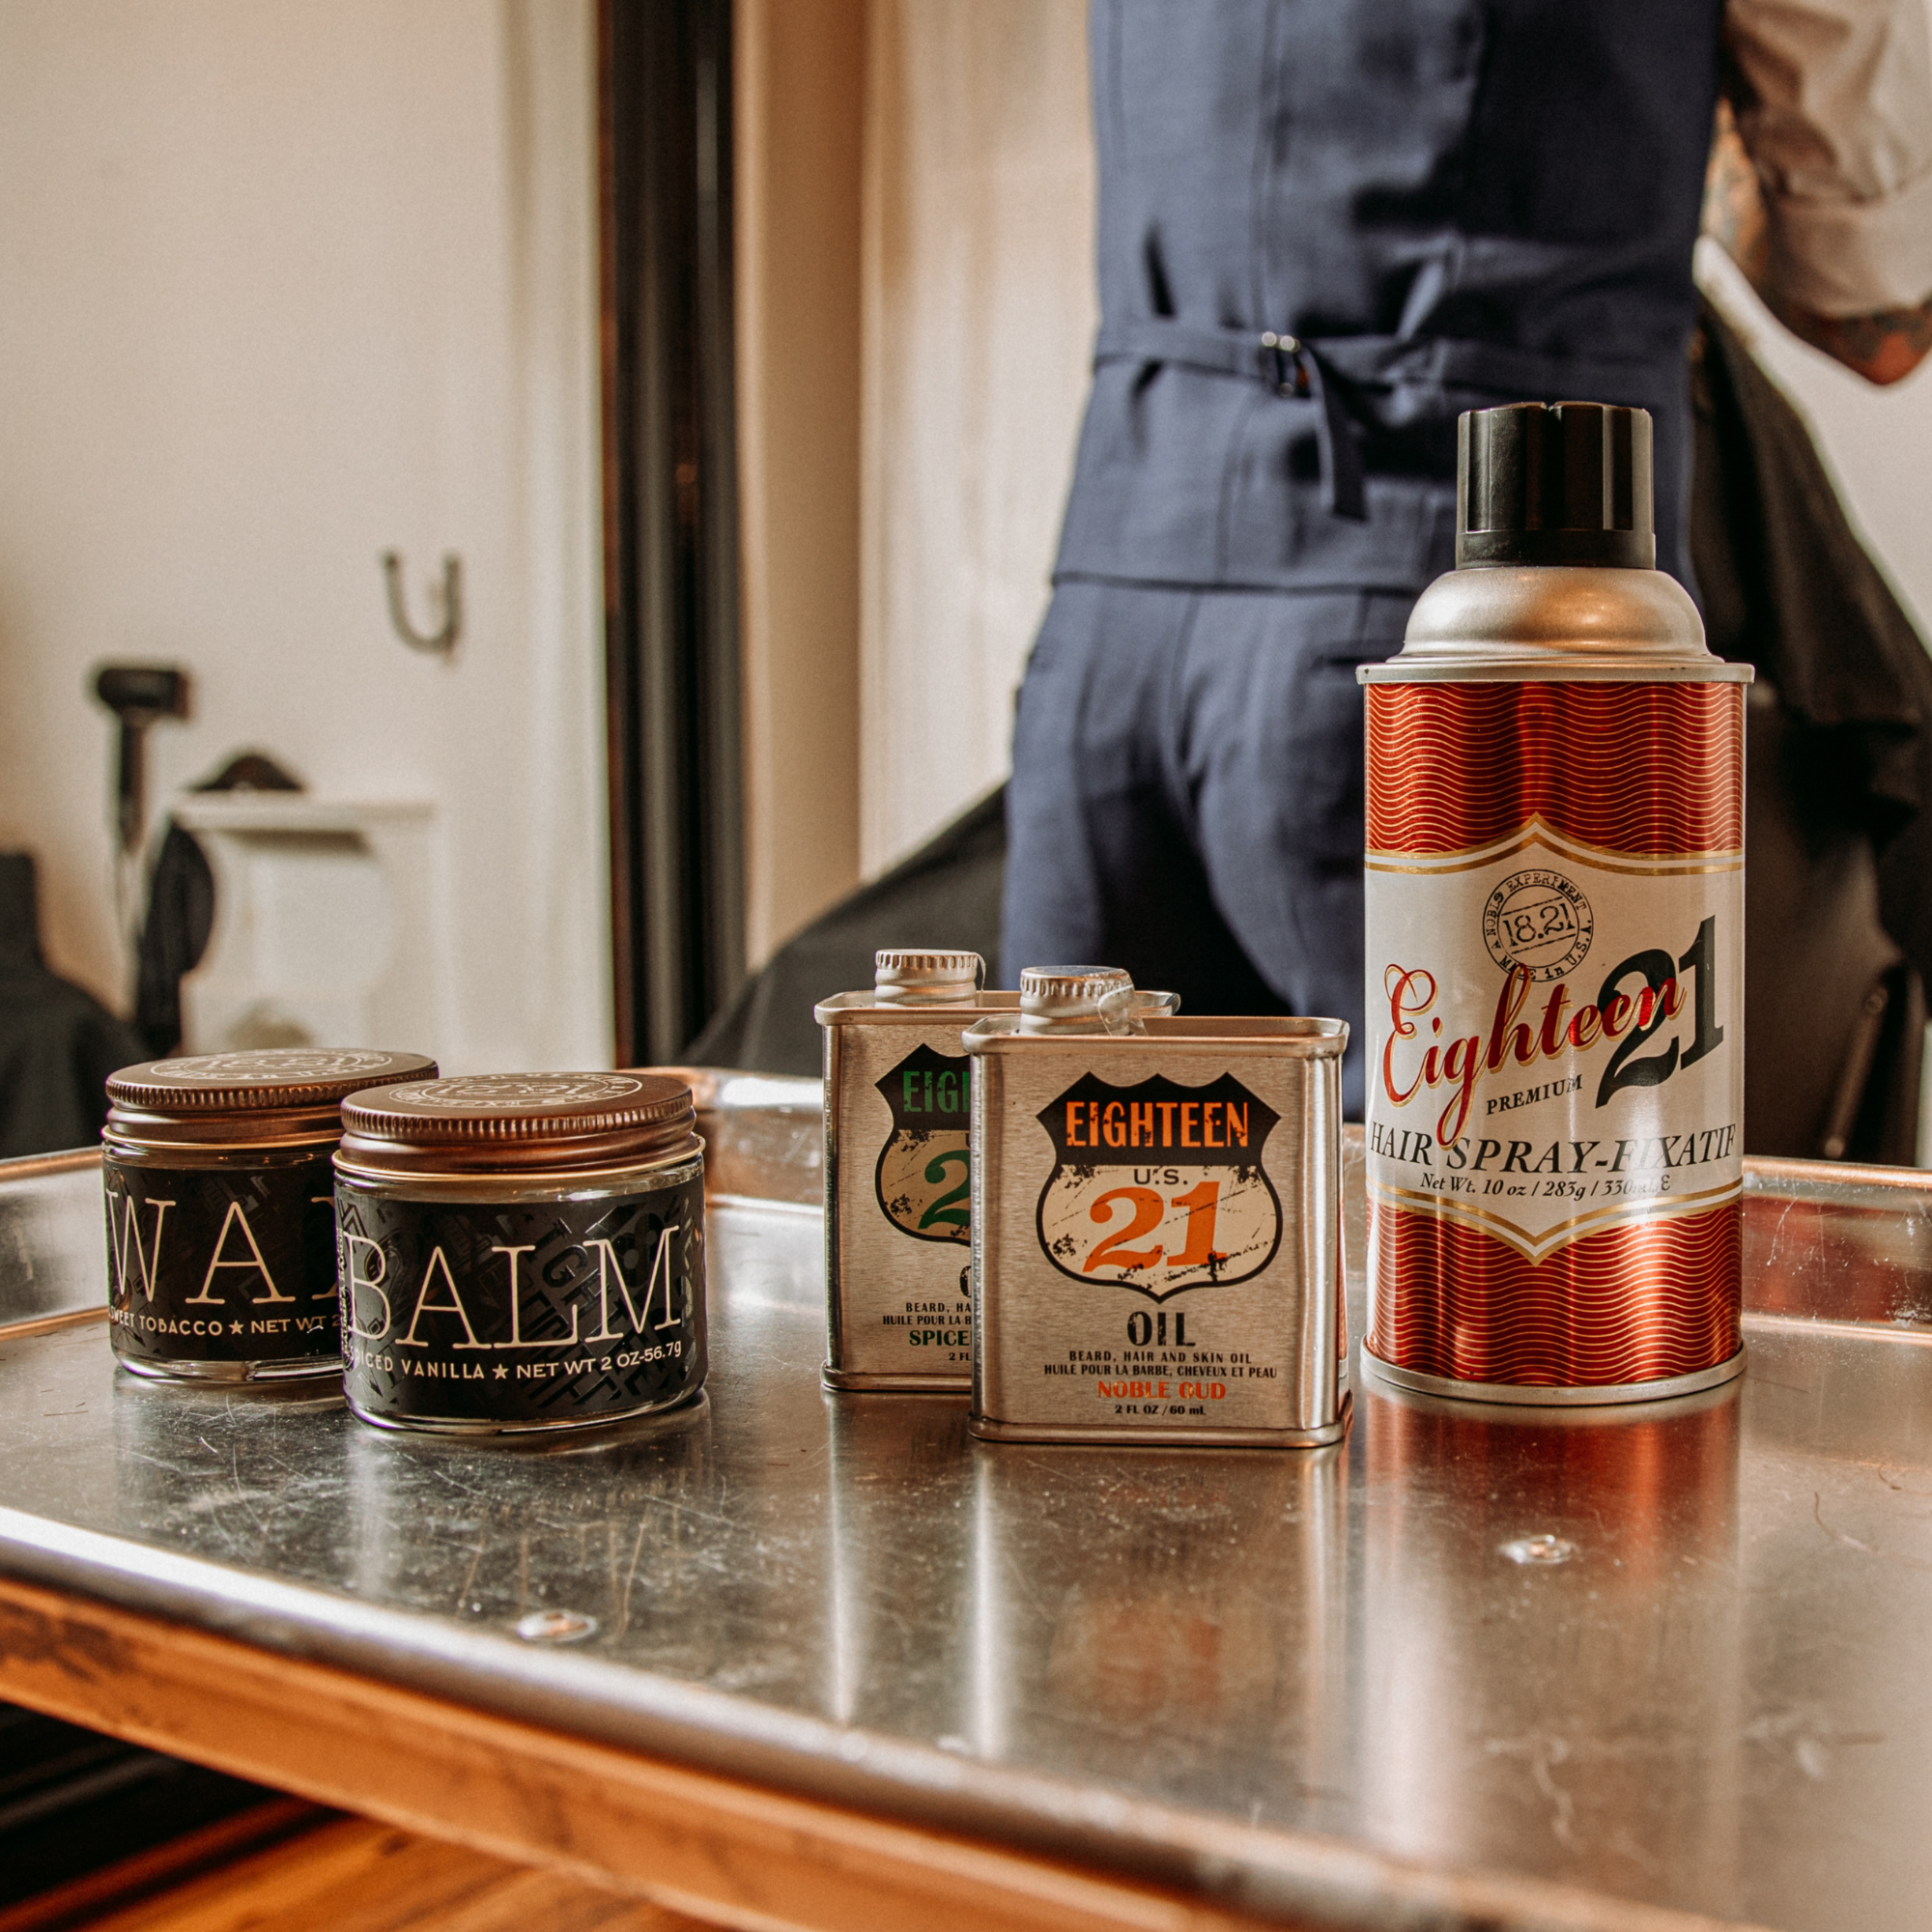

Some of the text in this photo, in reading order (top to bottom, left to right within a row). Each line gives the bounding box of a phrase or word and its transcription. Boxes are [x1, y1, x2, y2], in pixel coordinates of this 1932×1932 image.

[1505, 872, 1587, 911] EXPERIMENT
[1502, 902, 1577, 948] 18.21
[1499, 954, 1537, 981] MAE
[1595, 914, 1724, 1109] 21
[1382, 962, 1688, 1150] Eighteen
[902, 1070, 971, 1114] EIG
[1486, 1073, 1583, 1116] PREMIUM
[1065, 1100, 1248, 1149] EIGHTEEN
[1370, 1121, 1434, 1167] HAIR
[1133, 1168, 1188, 1185] U.S.
[1420, 1172, 1446, 1191] Net
[1450, 1176, 1477, 1194] Wt.
[1482, 1179, 1504, 1196] 10
[1506, 1184, 1527, 1197] oz
[1542, 1180, 1587, 1202] 283g
[105, 1187, 335, 1302] WA
[1082, 1180, 1228, 1273] 21
[343, 1225, 681, 1350] BALM
[139, 1315, 223, 1336] TOBACCO
[250, 1319, 291, 1334] NET
[296, 1315, 327, 1331] WT
[882, 1315, 913, 1325] HUILE
[917, 1315, 946, 1325] POUR
[949, 1315, 961, 1325] LA
[905, 1302, 972, 1314] BEARD, HA
[909, 1329, 972, 1347] SPICE
[1126, 1311, 1196, 1347] OIL
[401, 1358, 485, 1379] VANILLA
[516, 1362, 559, 1379] NET
[564, 1358, 596, 1376] WT
[600, 1356, 612, 1372] 2
[616, 1340, 682, 1368] OZ-56.7g
[948, 1351, 972, 1361] 2 FL
[1044, 1364, 1277, 1378] HUILE POUR LA BARBE, CHEVEUX ET PEAU
[1068, 1350, 1252, 1364] BEARD, HAIR AND SKIN OIL
[1097, 1380, 1226, 1400] NOBLE OUD
[1115, 1405, 1122, 1414] 2
[1126, 1405, 1141, 1414] FL
[1143, 1405, 1159, 1414] OZ
[1189, 1406, 1207, 1415] mL
